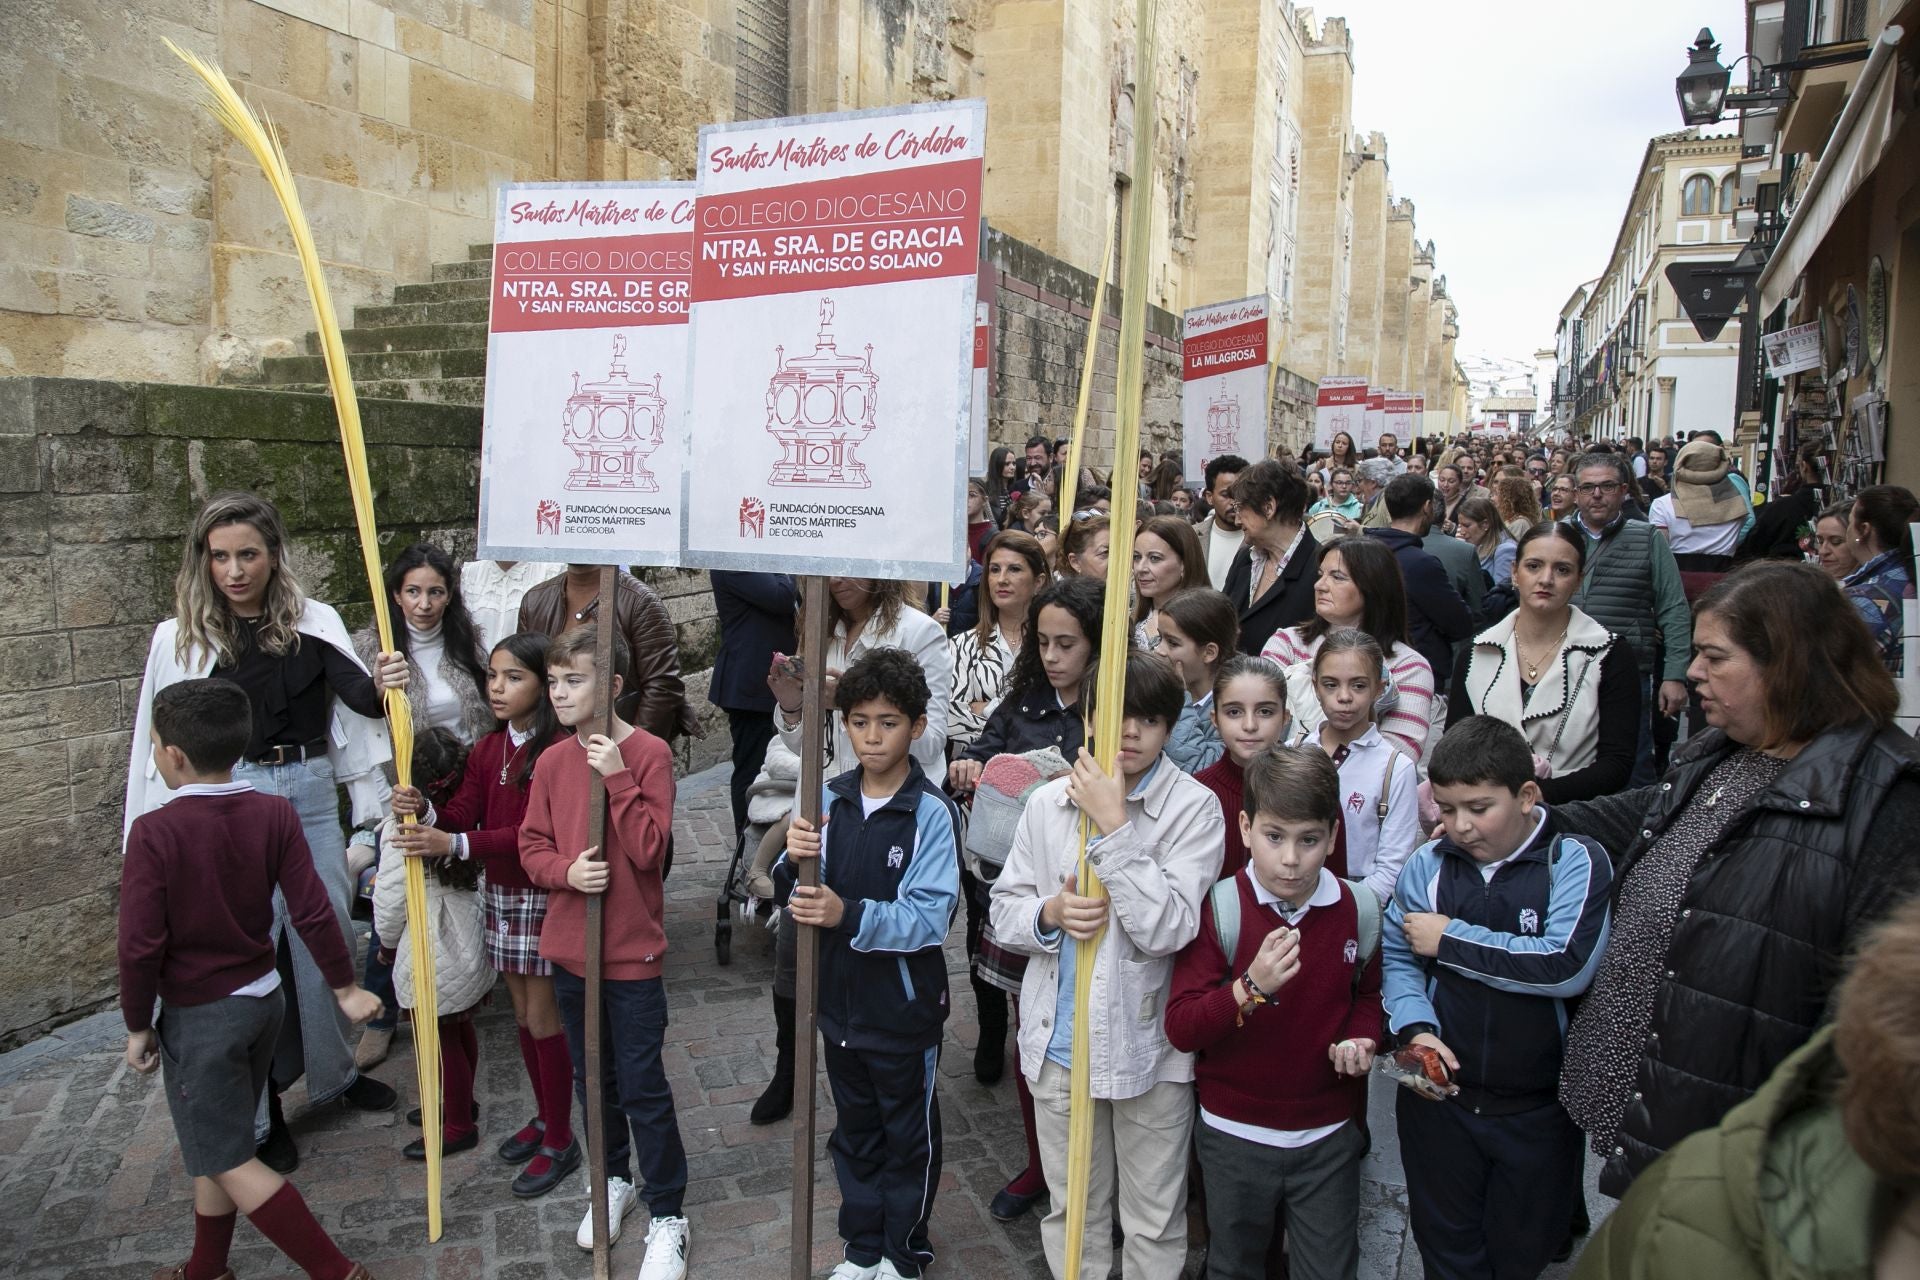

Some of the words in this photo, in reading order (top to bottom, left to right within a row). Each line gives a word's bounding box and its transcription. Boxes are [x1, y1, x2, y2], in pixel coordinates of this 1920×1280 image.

[710, 142, 768, 173] Santos
[768, 136, 850, 171] Mártires
[854, 132, 881, 157] de
[884, 125, 969, 159] Córdoba
[510, 201, 565, 224] Santos
[565, 199, 639, 227] Mártires
[644, 200, 668, 222] de
[703, 200, 808, 228] COLEGIO
[815, 188, 967, 221] DIOCESANO
[702, 238, 767, 260] NTRA.
[773, 235, 825, 257] SRA.
[832, 231, 864, 253] DE
[870, 226, 964, 251] GRACIA
[503, 251, 601, 270] COLEGIO
[718, 263, 729, 278] Y
[732, 261, 766, 278] SAN
[769, 255, 866, 275] FRANCISCO
[869, 252, 943, 272] SOLANO
[502, 280, 564, 298] NTRA.
[570, 280, 617, 298] SRA.
[624, 280, 653, 298] DE
[658, 280, 691, 298] GR
[518, 300, 529, 313] Y
[531, 300, 563, 314] SAN
[566, 300, 655, 314] FRANCISCO
[1229, 309, 1238, 320] de
[1185, 339, 1218, 354] COLEGIO
[1218, 331, 1265, 349] DIOCESANO
[1191, 356, 1203, 368] LA
[1204, 348, 1257, 366] MILAGROSA
[565, 503, 618, 514] FUNDACIÓN
[619, 506, 671, 516] DIOCESANA
[769, 502, 826, 514] FUNDACIÓN
[828, 505, 885, 516] DIOCESANA
[564, 515, 601, 524] SANTOS
[602, 515, 646, 526] MÁRTIRES
[769, 515, 808, 526] SANTOS
[809, 515, 857, 528] MÁRTIRES
[564, 525, 576, 534] DE
[576, 525, 616, 535] CÓRDOBA
[769, 528, 780, 537] DE
[781, 527, 824, 538] CÓRDOBA
